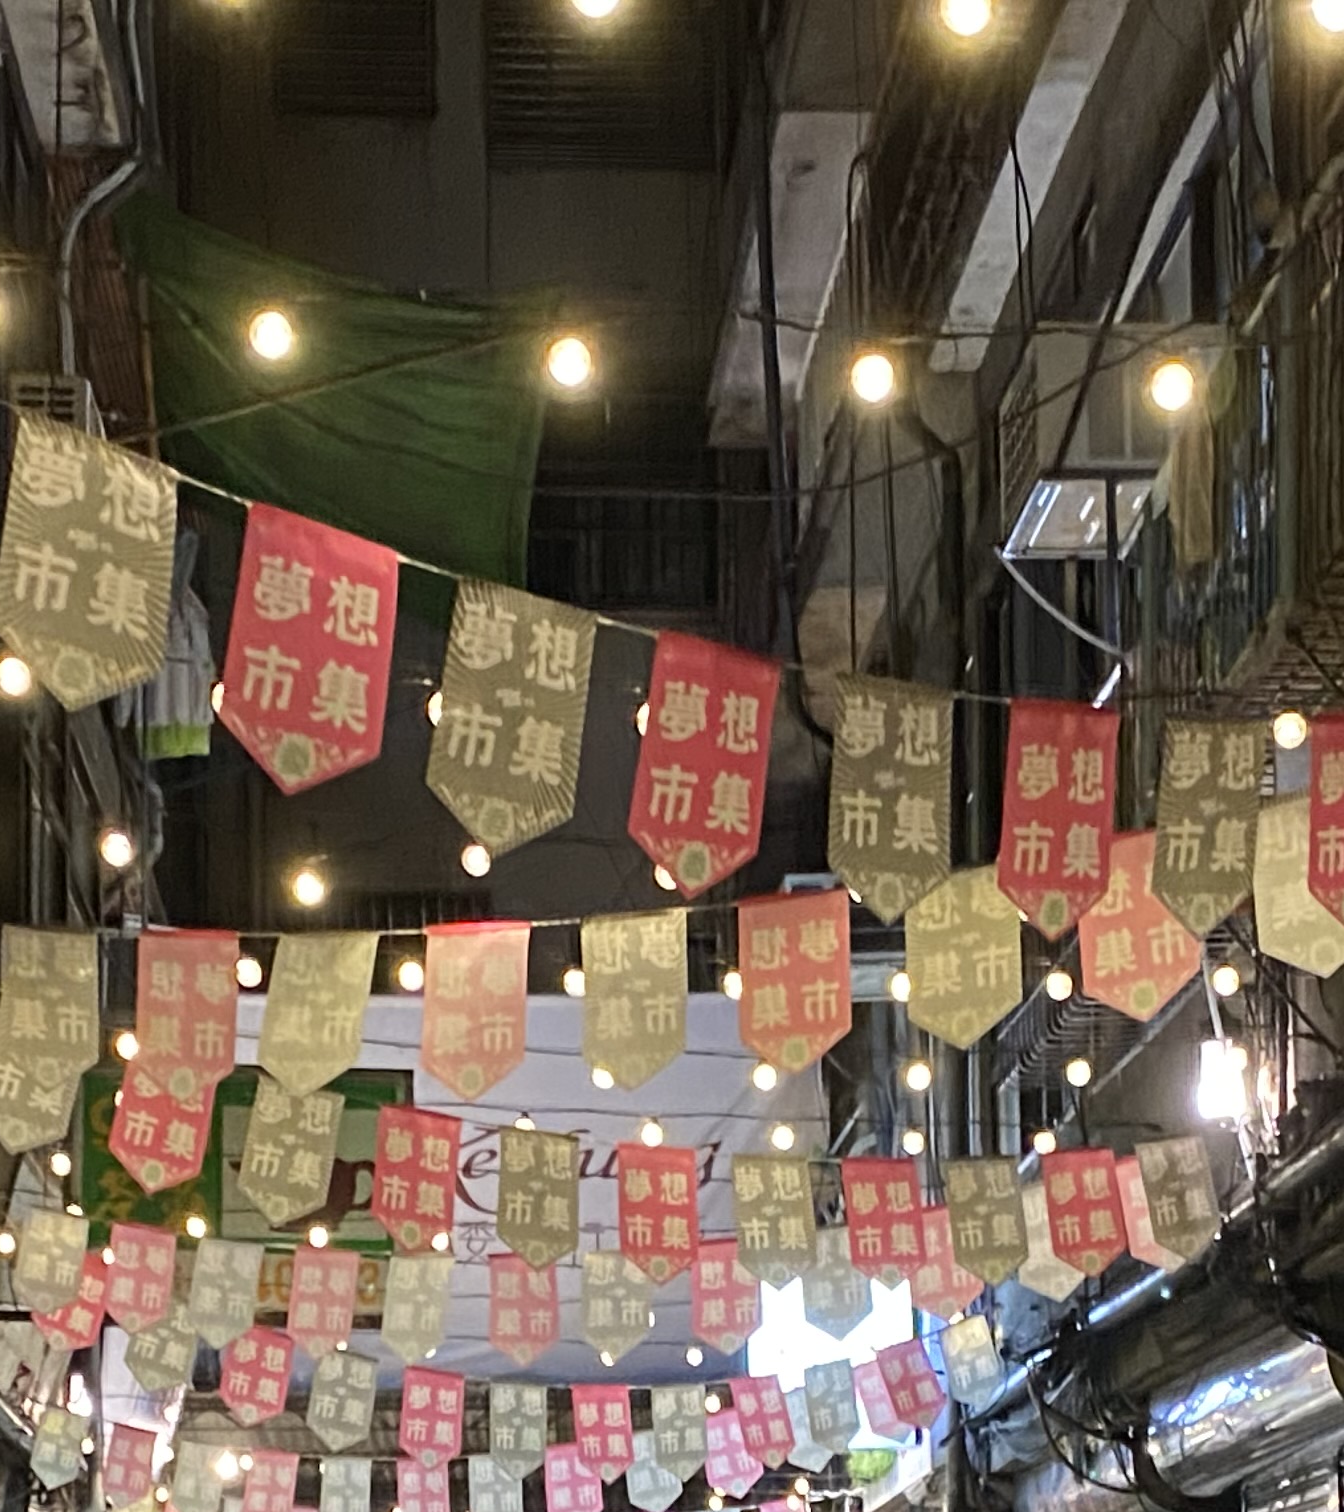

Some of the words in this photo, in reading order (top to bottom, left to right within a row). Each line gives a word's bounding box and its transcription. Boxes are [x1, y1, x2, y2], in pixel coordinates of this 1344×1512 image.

[20, 442, 159, 542] 夢想
[12, 542, 150, 640] 市集
[253, 555, 380, 648] 夢想
[457, 602, 577, 692] 夢想
[242, 644, 370, 734] 市集
[658, 680, 760, 755] 夢想
[840, 694, 941, 767] 夢想
[446, 704, 565, 785] 市集
[1168, 732, 1257, 792] 夢想
[1016, 743, 1105, 804] 夢想
[649, 763, 754, 835] 市集
[840, 790, 939, 855] 市集
[1165, 818, 1250, 873] 市集
[1012, 821, 1102, 880] 市集
[257, 1083, 333, 1135] 夢想
[124, 1110, 197, 1160] 市集
[384, 1127, 451, 1172] 夢想
[505, 1136, 573, 1180] 夢想
[250, 1143, 322, 1189] 市集
[624, 1168, 689, 1206] 夢想
[733, 1165, 804, 1201] 夢想
[949, 1168, 1015, 1200] 夢想
[1050, 1168, 1110, 1203] 夢想
[382, 1175, 447, 1218] 市集
[506, 1191, 571, 1231] 市集
[850, 1182, 914, 1214] 夢想
[625, 1214, 690, 1250] 市集
[740, 1217, 808, 1250] 市集
[856, 1223, 918, 1257] 市集
[957, 1214, 1020, 1249] 市集
[1058, 1209, 1116, 1243] 市集
[409, 1385, 456, 1414] 夢想
[407, 1419, 454, 1446] 市集
